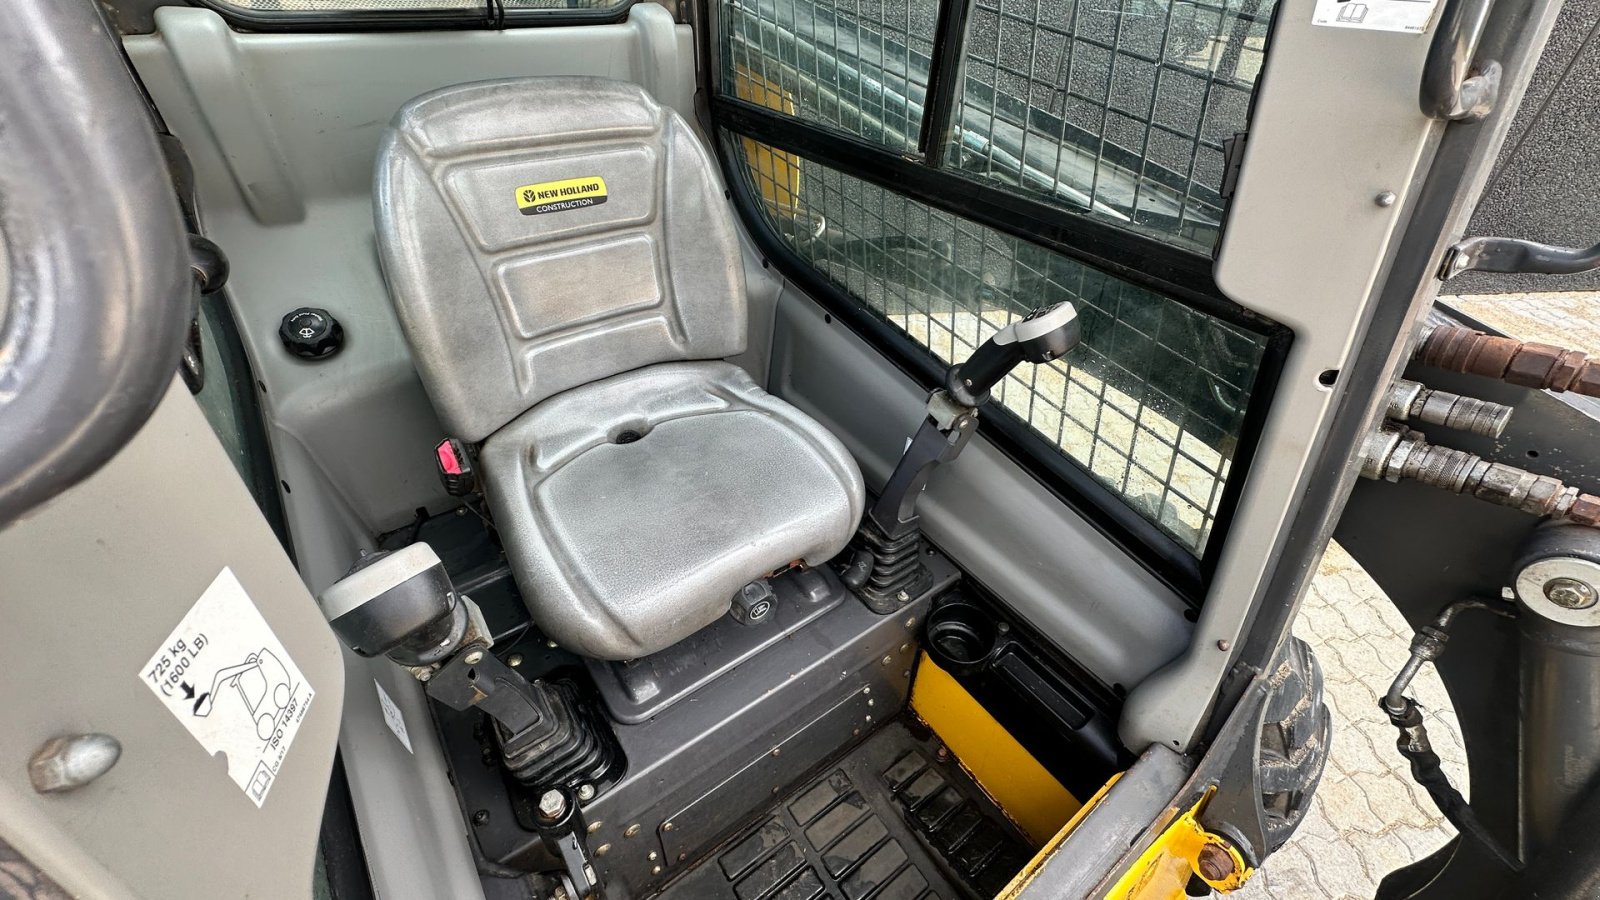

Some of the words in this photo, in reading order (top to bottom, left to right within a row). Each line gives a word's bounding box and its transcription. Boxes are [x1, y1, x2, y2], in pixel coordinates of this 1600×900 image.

[536, 198, 593, 213] CONSTRUCTION
[537, 189, 558, 200] NEW
[559, 183, 600, 196] HOLLAND
[148, 655, 172, 683] 725
[169, 638, 187, 658] kg
[160, 657, 190, 697] (1600
[187, 633, 209, 658] LB)
[270, 728, 284, 750] ISO
[282, 698, 298, 727] 14397
